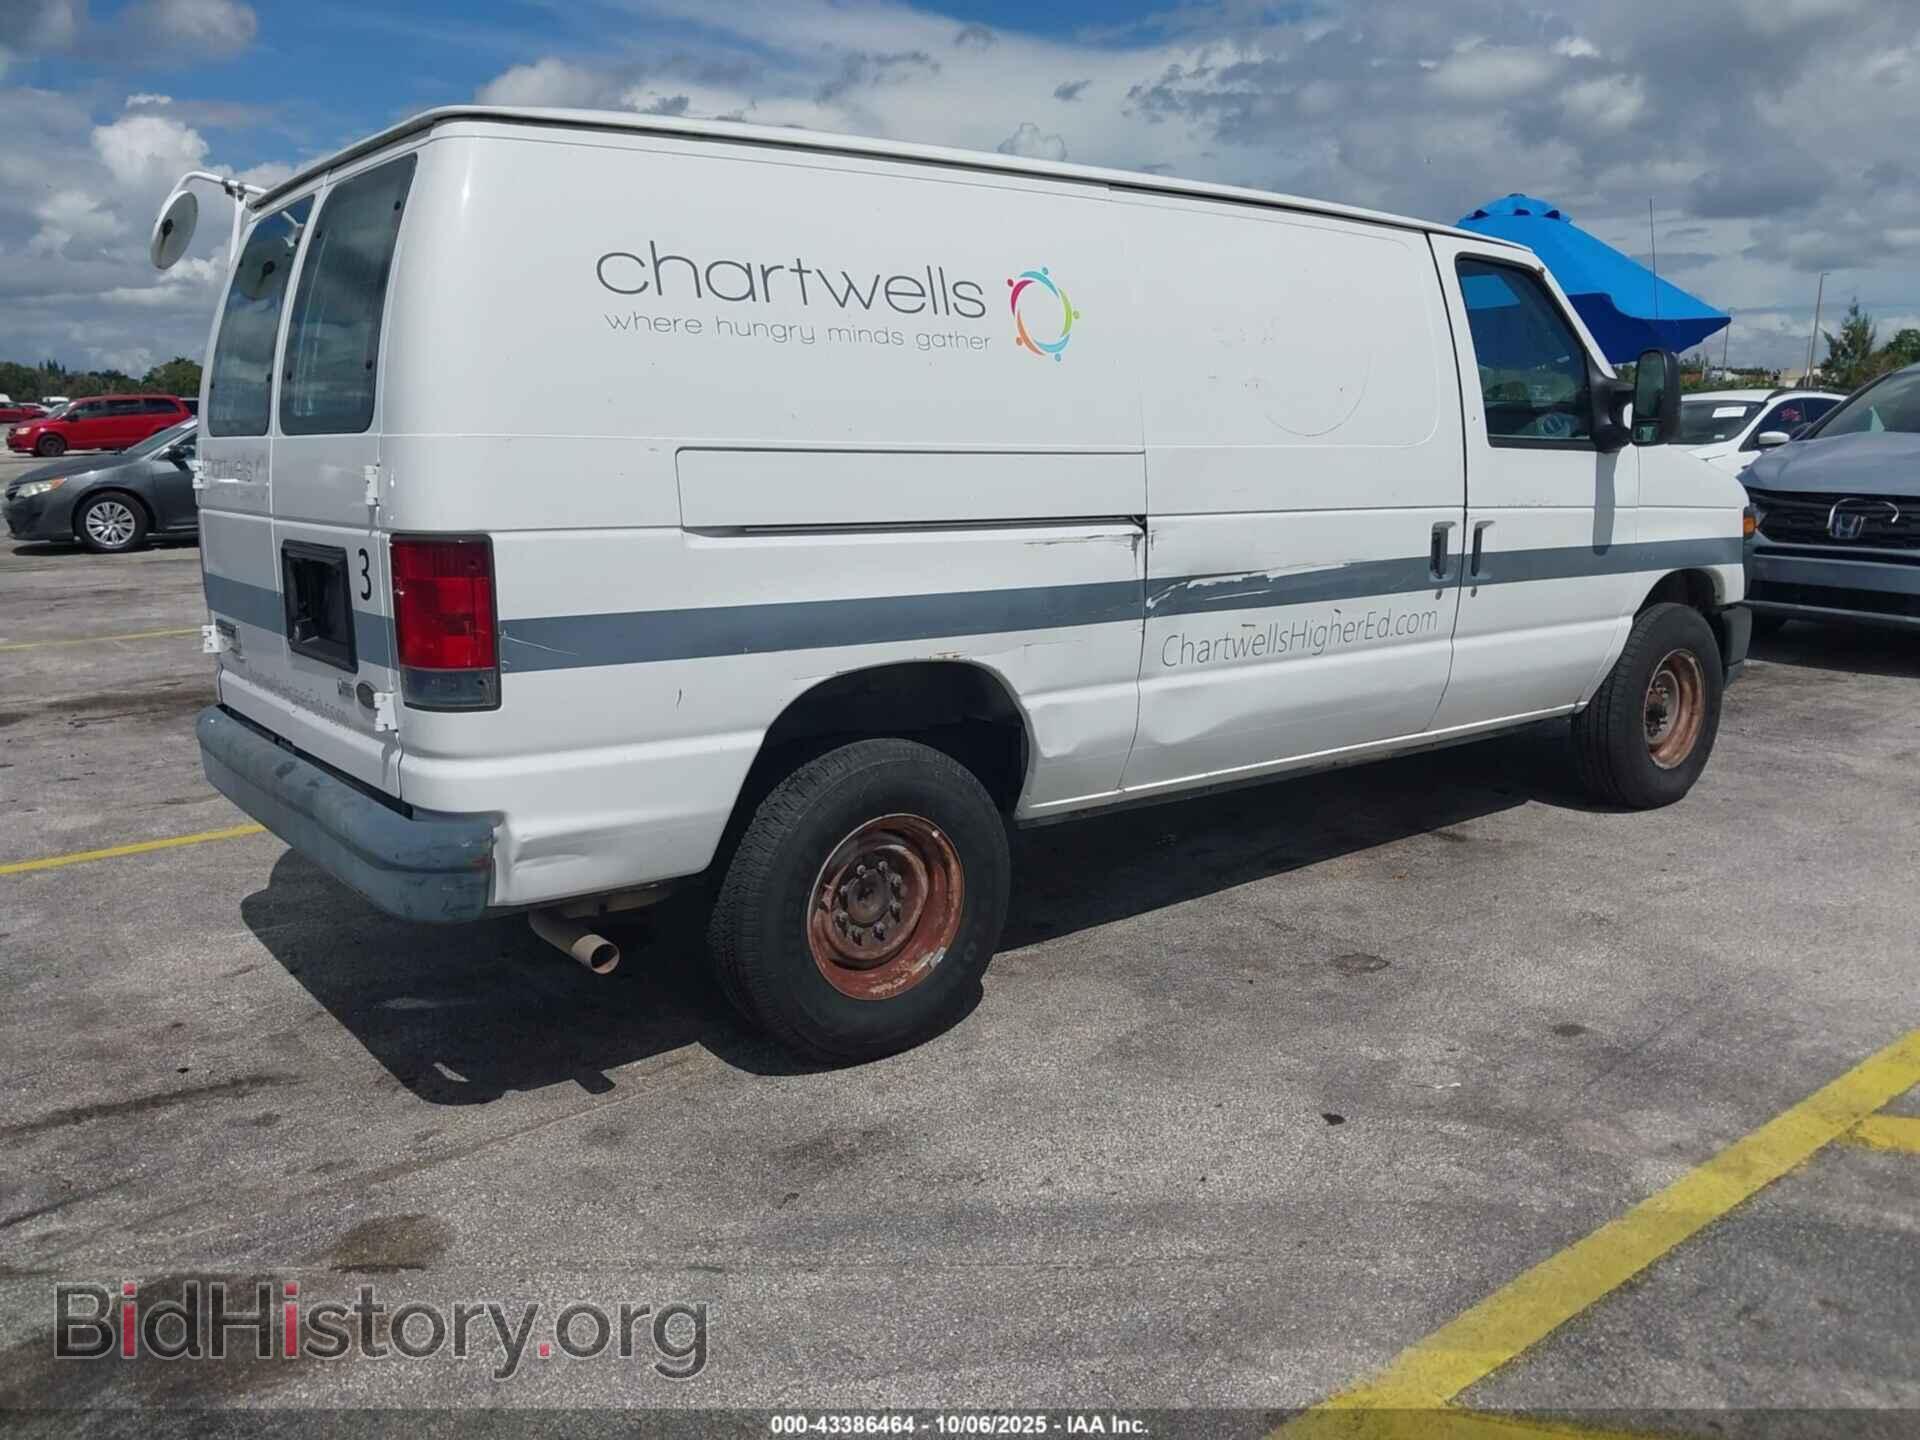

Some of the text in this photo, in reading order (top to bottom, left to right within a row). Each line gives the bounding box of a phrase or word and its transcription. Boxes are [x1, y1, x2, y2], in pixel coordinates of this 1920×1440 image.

[595, 240, 987, 319] chartwells
[604, 311, 992, 352] where hungry minds gather
[358, 548, 372, 601] 3
[1161, 607, 1438, 668] ChartwellsHigherEd.com
